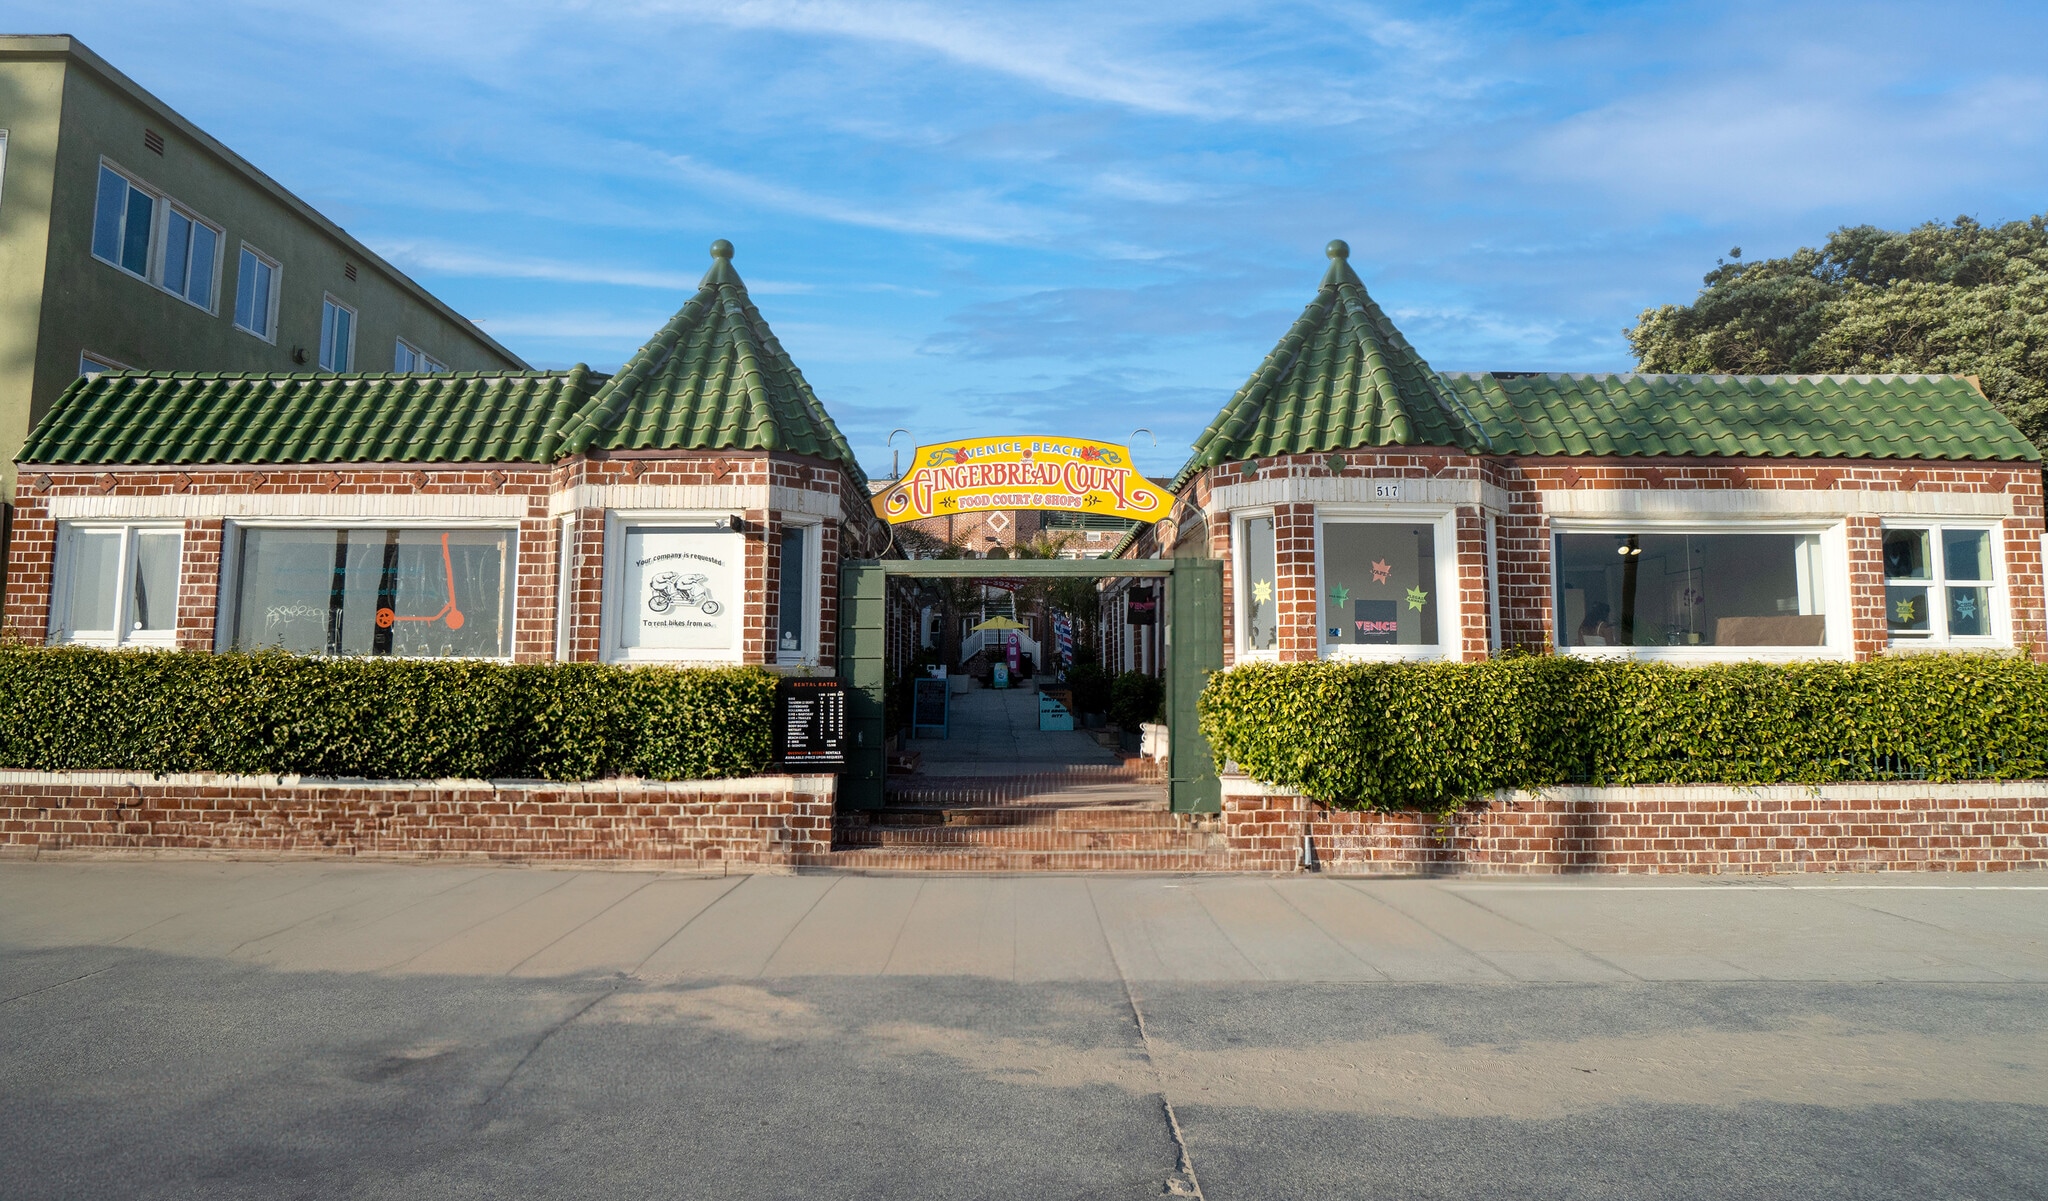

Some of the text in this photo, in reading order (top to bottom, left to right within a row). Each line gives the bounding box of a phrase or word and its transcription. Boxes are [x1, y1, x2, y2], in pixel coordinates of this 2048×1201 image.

[965, 442, 1082, 459] VENICE BEACH
[885, 461, 1158, 515] GINGERBREAD COURT
[1376, 485, 1398, 497] 517
[958, 494, 1082, 509] FOOD COURT & SHOPS
[635, 556, 652, 568] Your
[653, 551, 682, 562] company
[684, 551, 690, 559] is
[643, 619, 652, 627] To
[668, 619, 686, 627] bikes
[687, 619, 703, 627] from
[1355, 620, 1398, 631] VENICE
